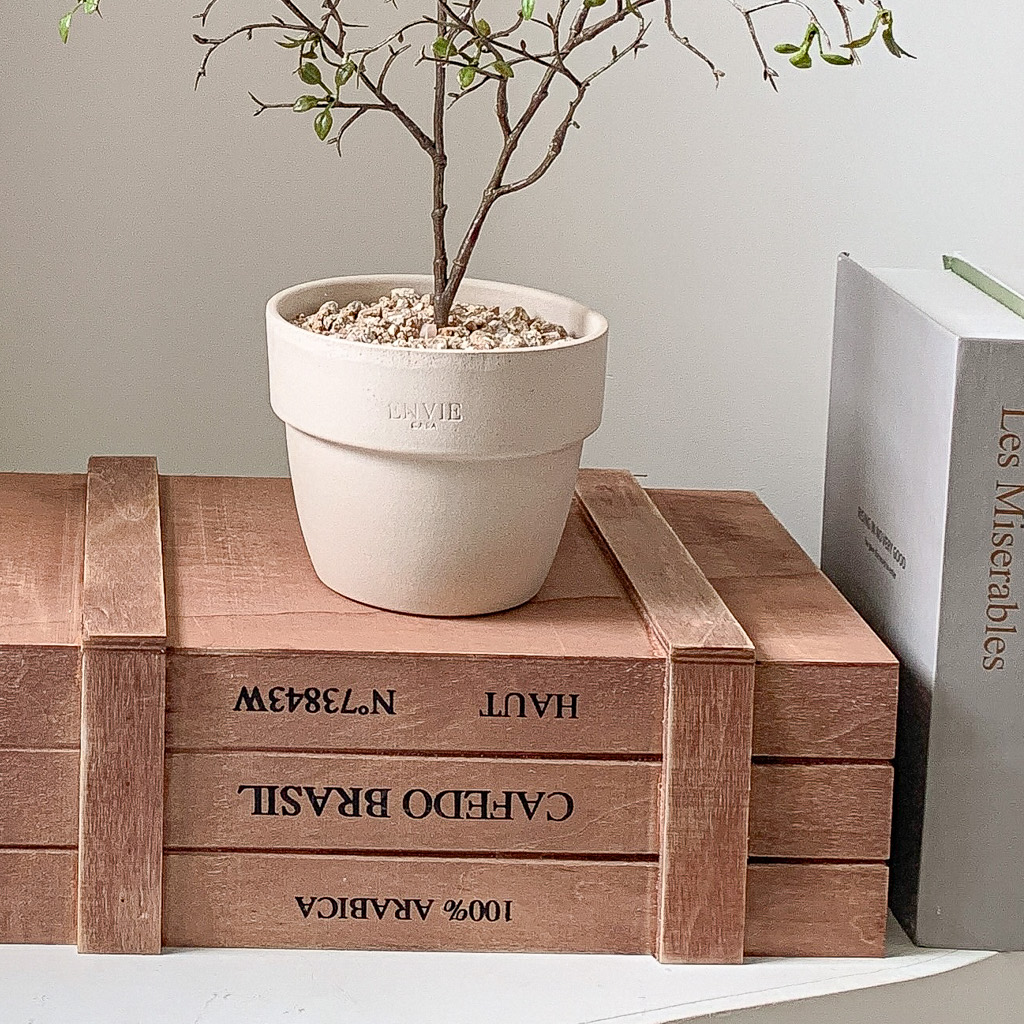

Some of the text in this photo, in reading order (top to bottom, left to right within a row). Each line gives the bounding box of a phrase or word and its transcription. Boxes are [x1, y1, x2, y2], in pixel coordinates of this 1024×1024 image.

[388, 402, 463, 421] ENVIE
[983, 405, 1024, 670] Les Miserables
[233, 686, 579, 719] HAUT N°73843W
[238, 784, 574, 822] CAFEDO BRASIL
[294, 896, 513, 923] 100% ARABICA
